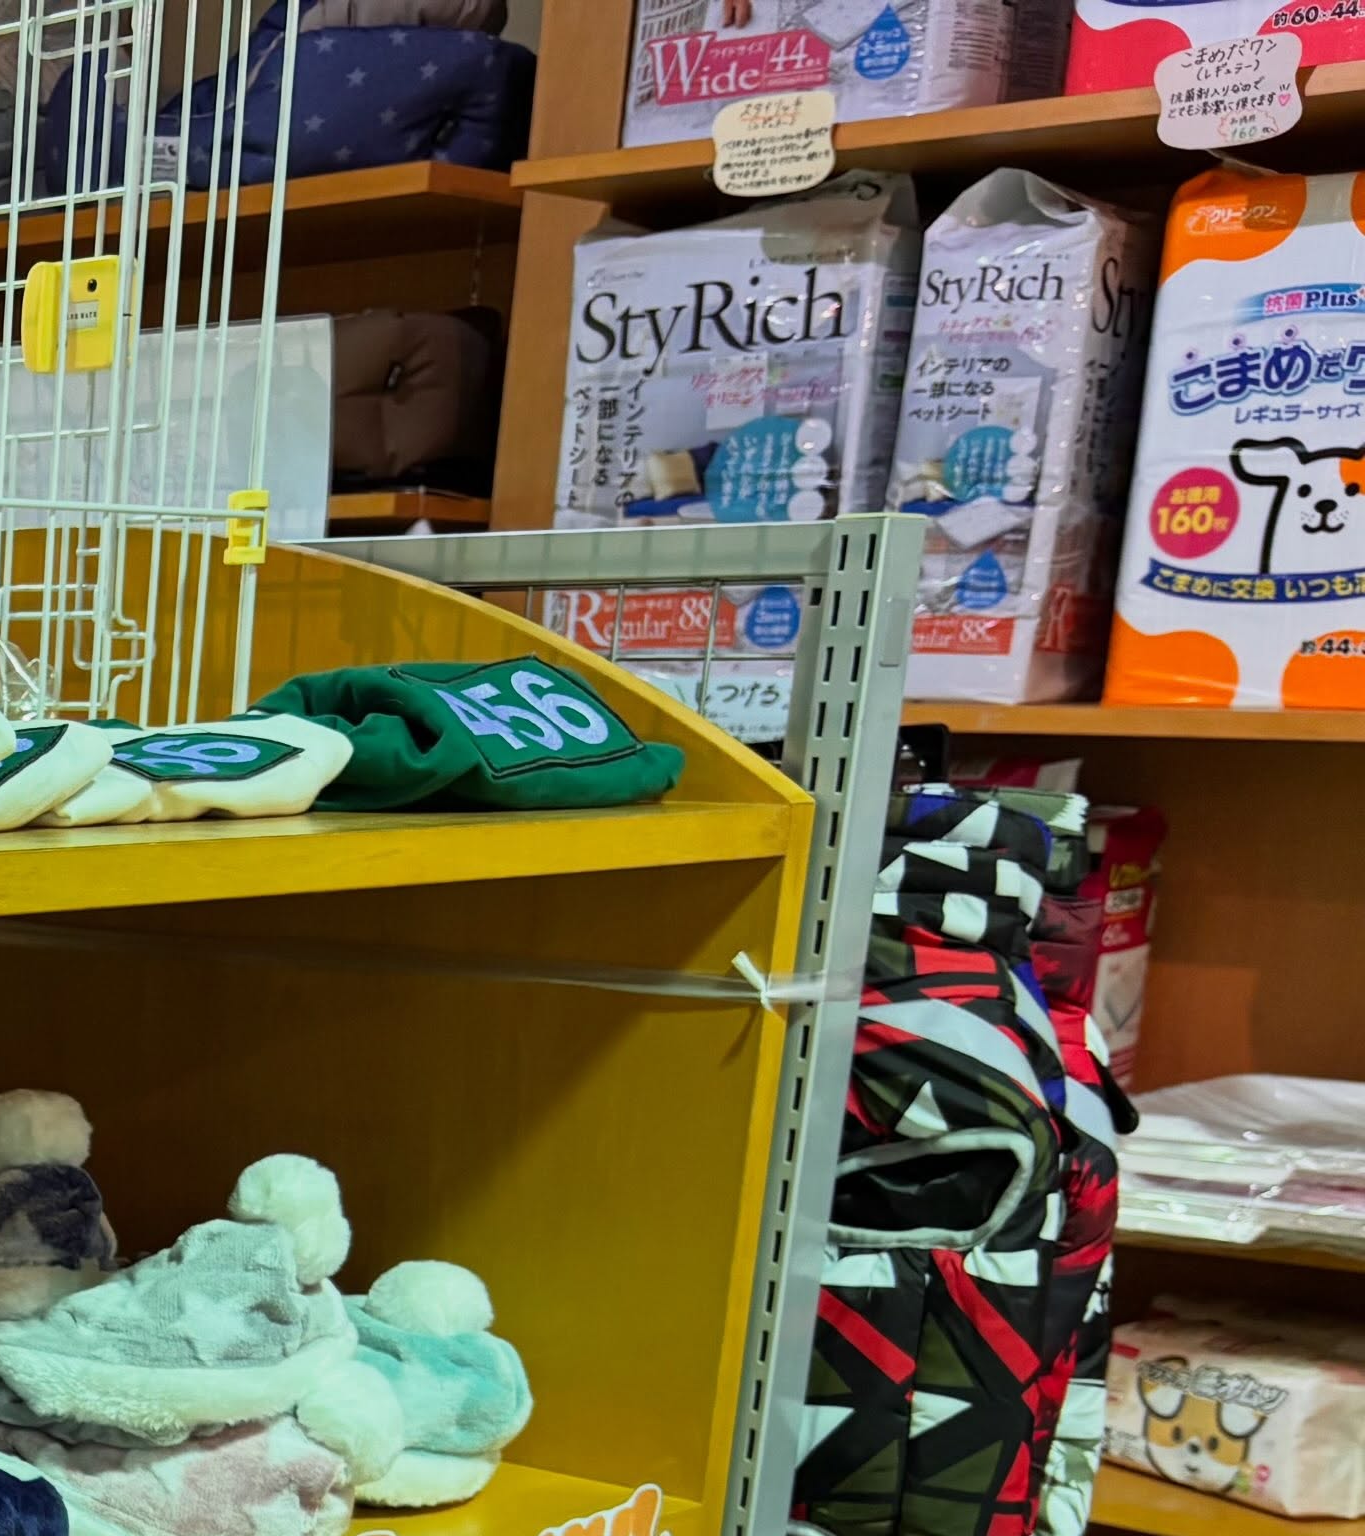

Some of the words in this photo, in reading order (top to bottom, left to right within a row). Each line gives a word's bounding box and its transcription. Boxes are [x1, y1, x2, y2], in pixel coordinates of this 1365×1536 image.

[648, 34, 762, 100] Wide
[1180, 37, 1278, 69] こまめだワン
[921, 261, 1065, 314] StyRich
[575, 266, 855, 378] StyRich
[916, 355, 1012, 376] インテリアの
[1234, 402, 1362, 425] レギュラーサイズ
[434, 669, 609, 753] 456
